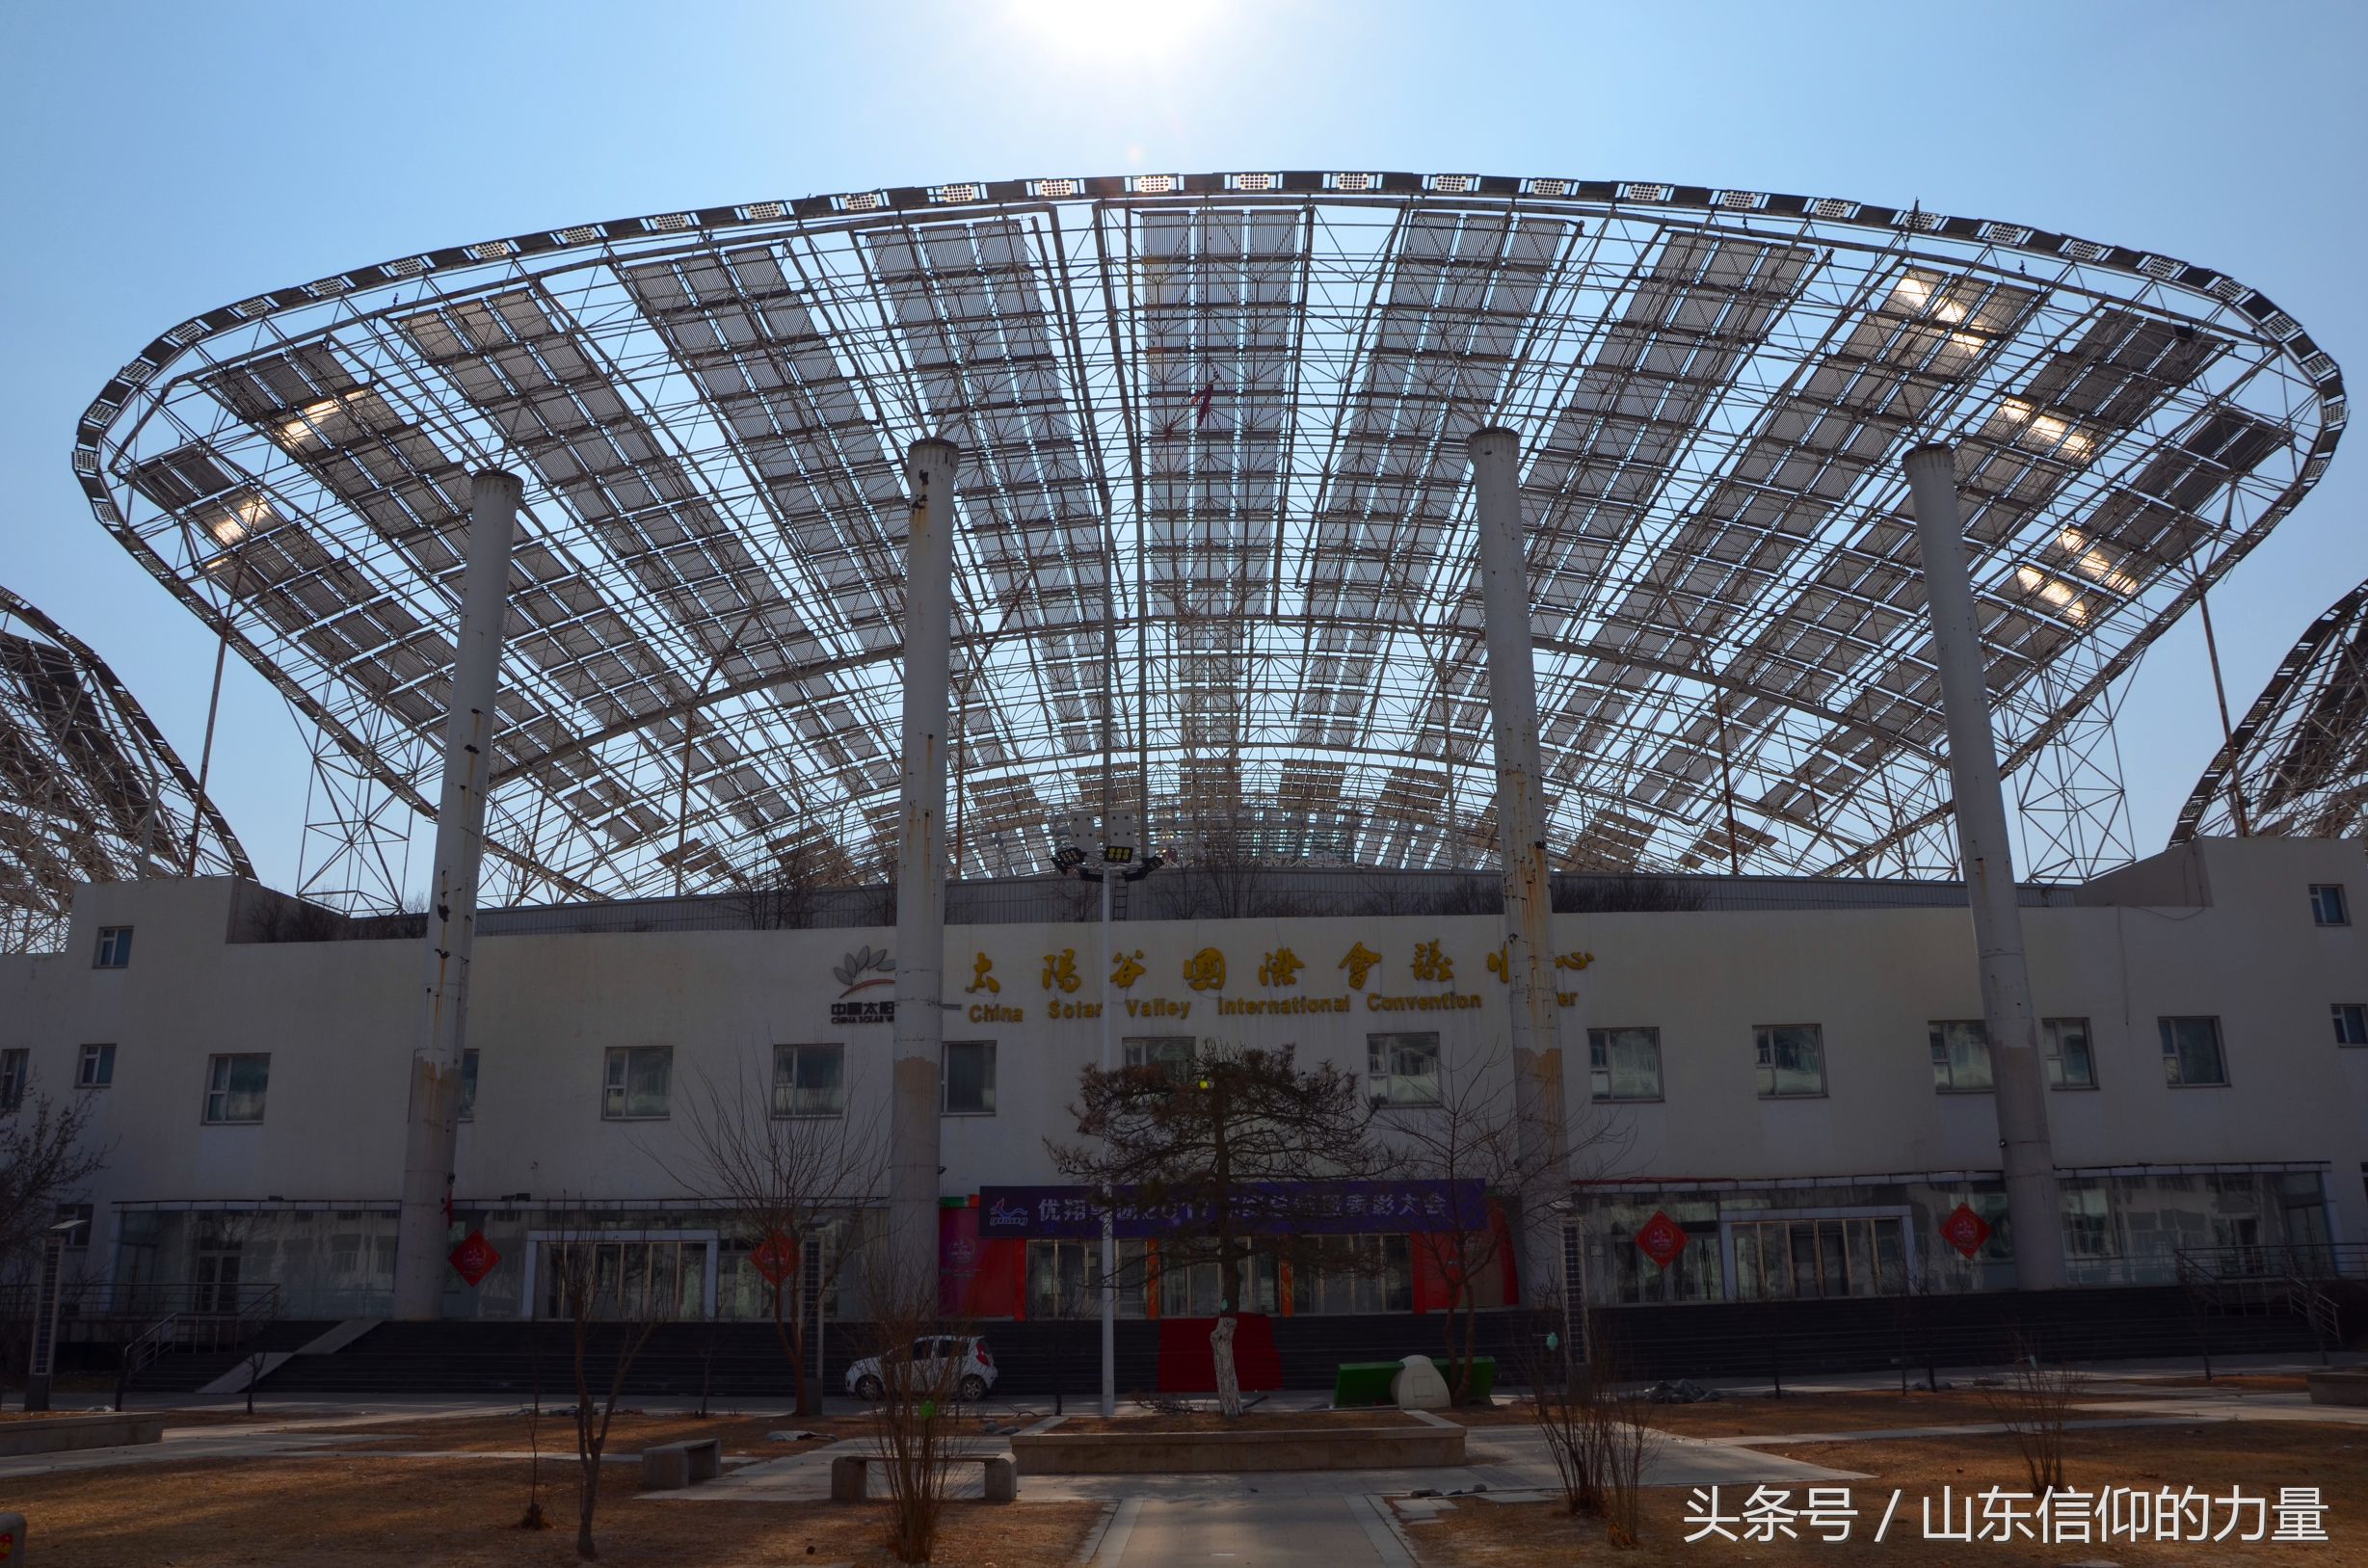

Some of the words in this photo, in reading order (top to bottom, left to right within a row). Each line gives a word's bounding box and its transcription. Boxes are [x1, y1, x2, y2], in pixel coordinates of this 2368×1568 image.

[969, 1004, 1024, 1023] China
[1048, 1000, 1103, 1019] Solar
[1125, 998, 1191, 1020] Valley
[1217, 995, 1350, 1015] International
[1367, 993, 1481, 1012] Convention
